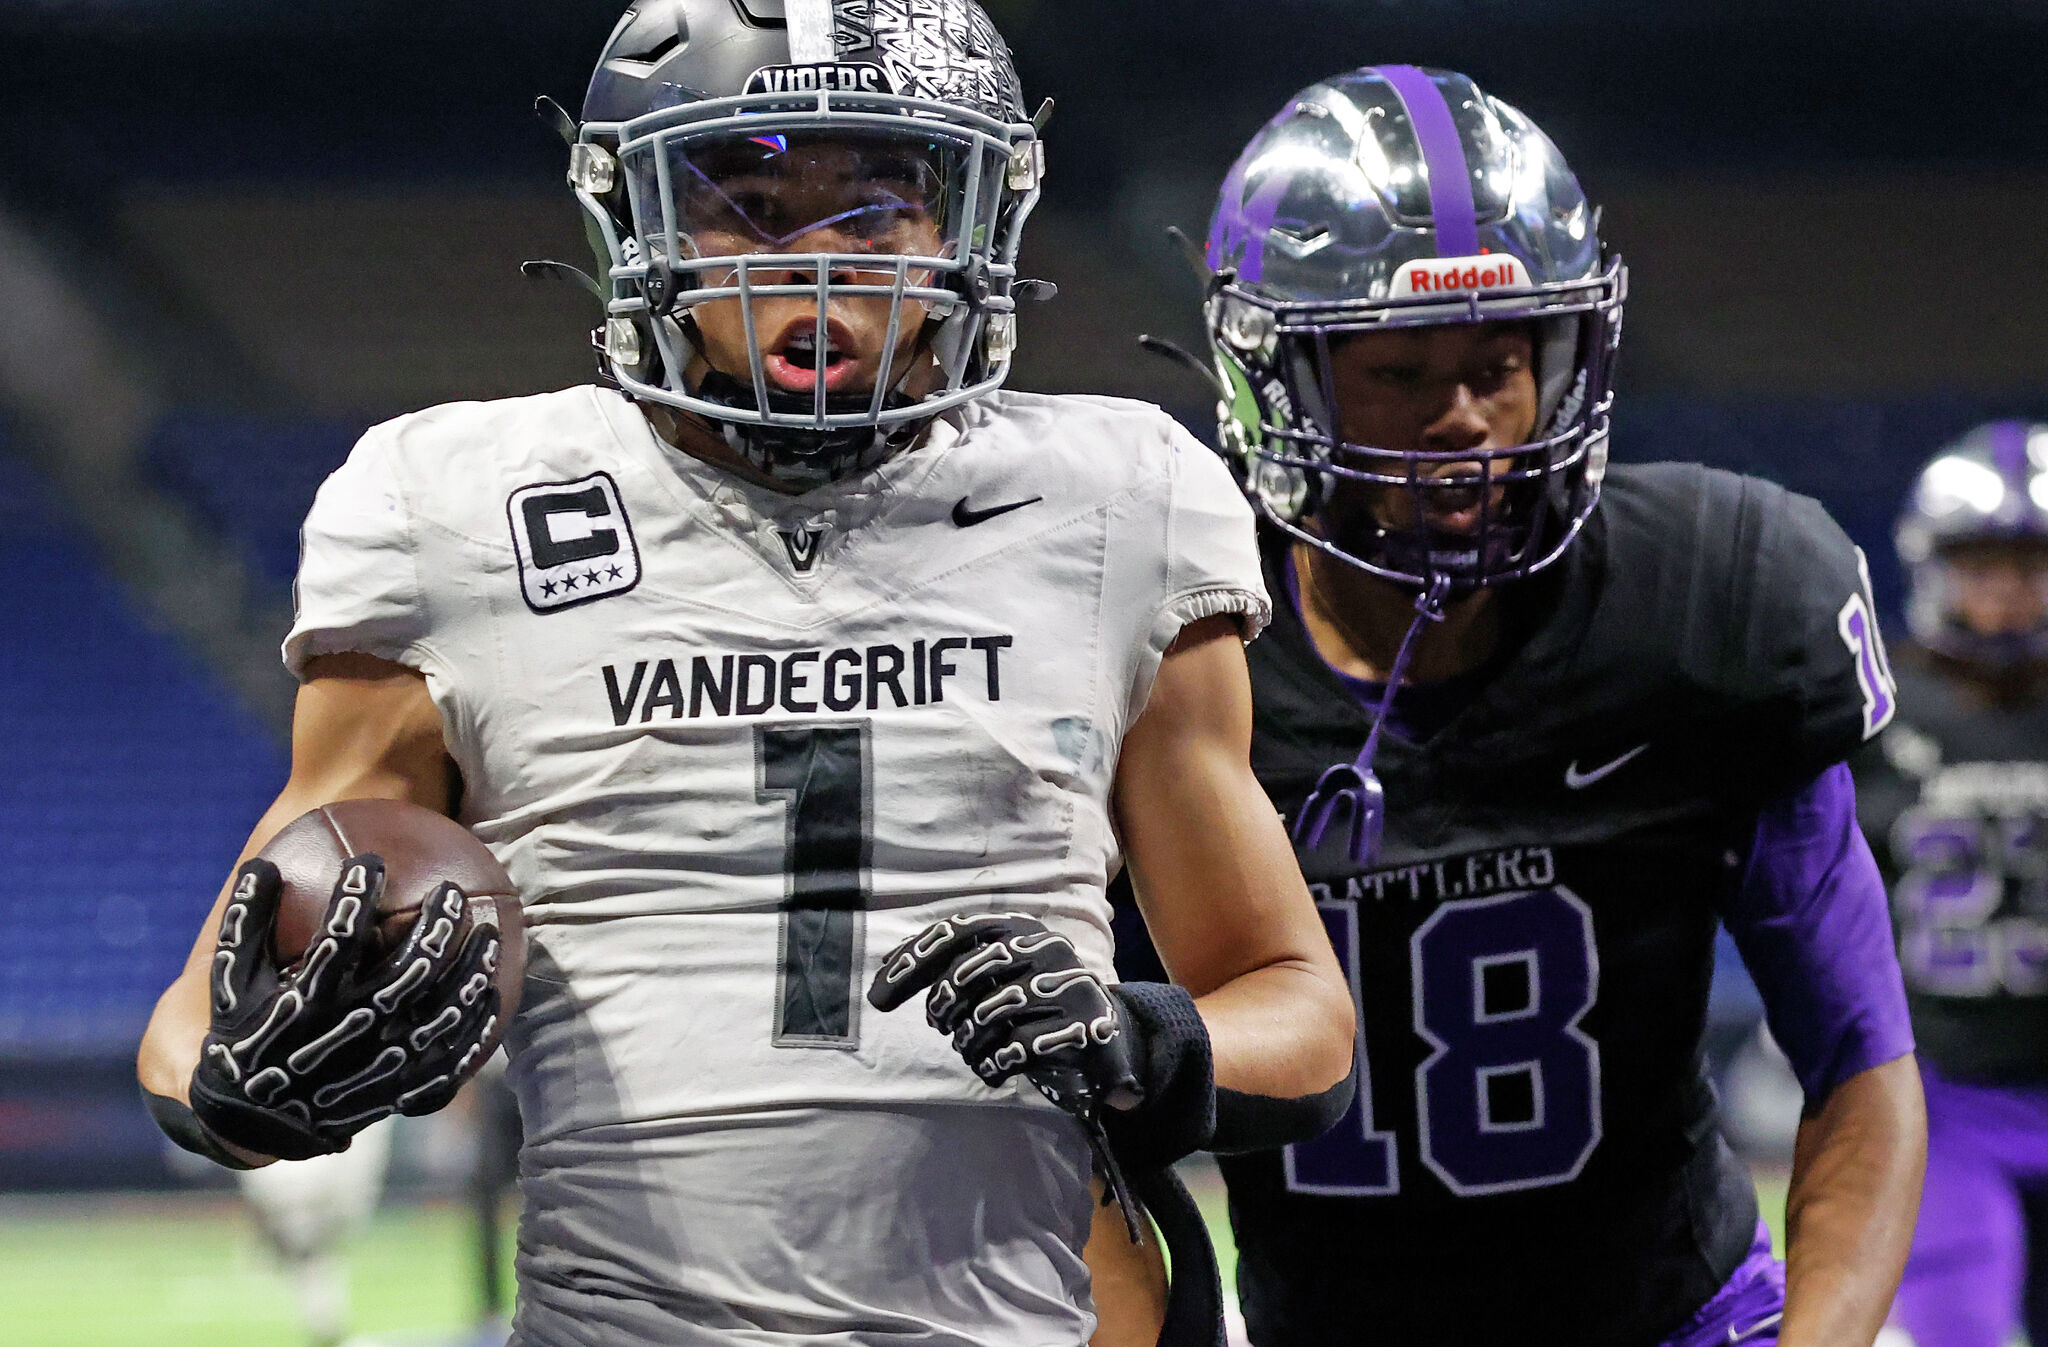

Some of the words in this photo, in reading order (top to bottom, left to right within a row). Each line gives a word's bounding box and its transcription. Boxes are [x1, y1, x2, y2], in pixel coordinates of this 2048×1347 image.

[762, 66, 880, 100] VIPERS
[1410, 264, 1515, 292] Riddell
[523, 486, 620, 569] C
[602, 635, 1013, 727] VANDEGRIFT
[753, 718, 874, 1050] 1
[1282, 886, 1603, 1198] 18
